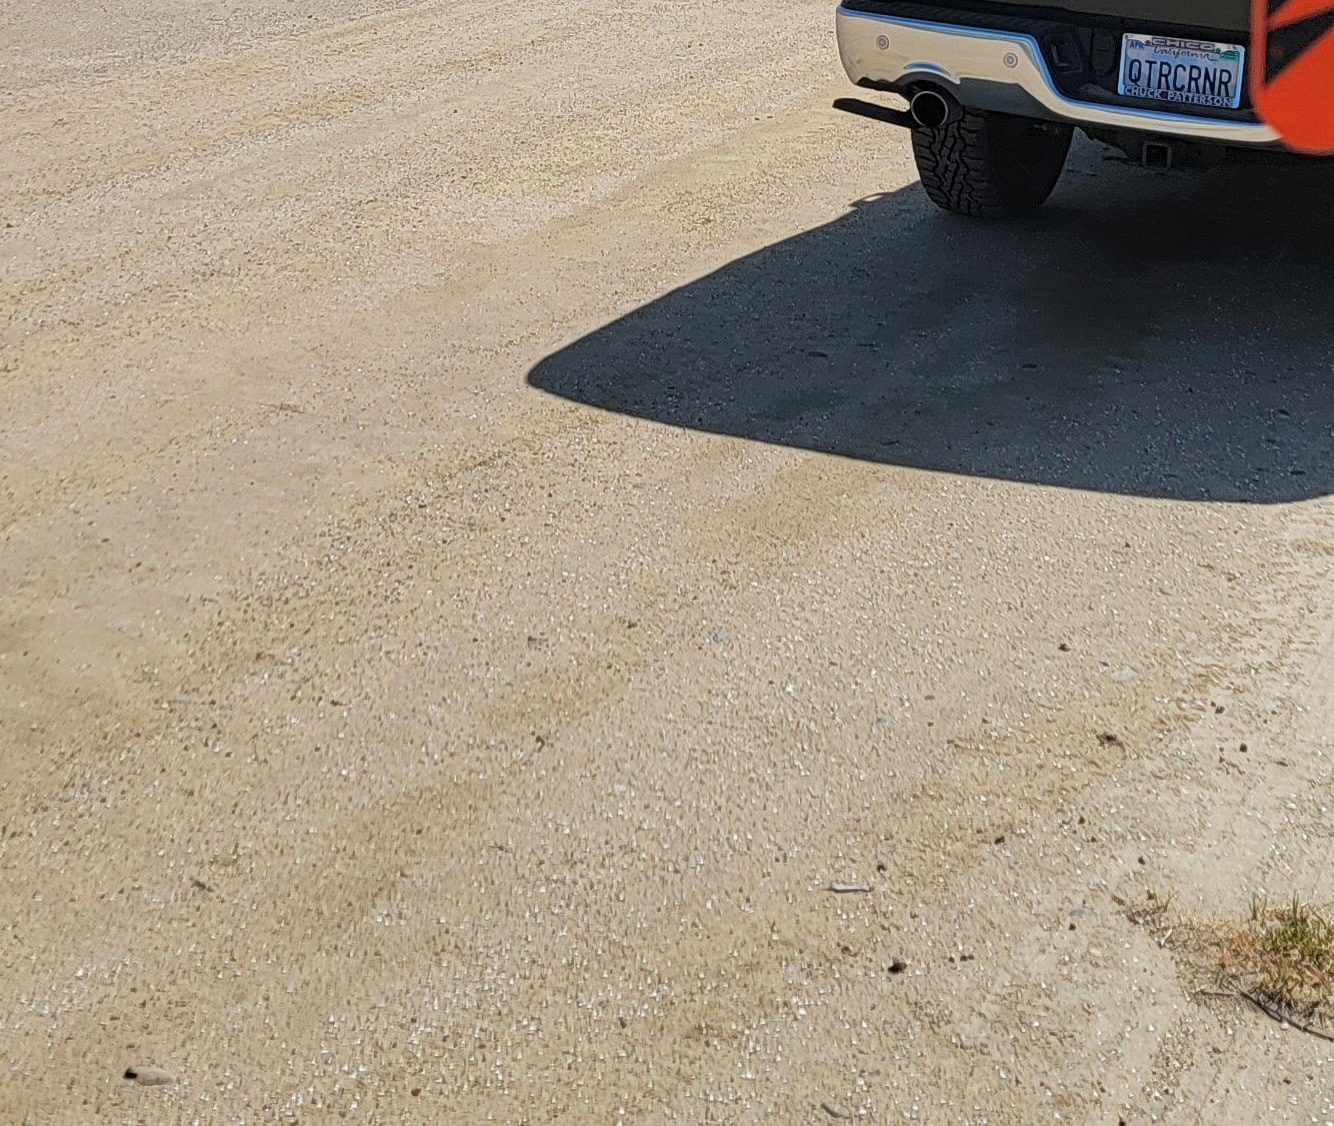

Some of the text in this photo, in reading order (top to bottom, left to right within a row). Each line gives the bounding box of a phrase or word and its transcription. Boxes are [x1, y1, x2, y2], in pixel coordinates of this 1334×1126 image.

[1152, 37, 1215, 51] CHICO
[1128, 59, 1232, 97] QTRCRNR
[1124, 86, 1232, 107] CHUCK PATTERSON
